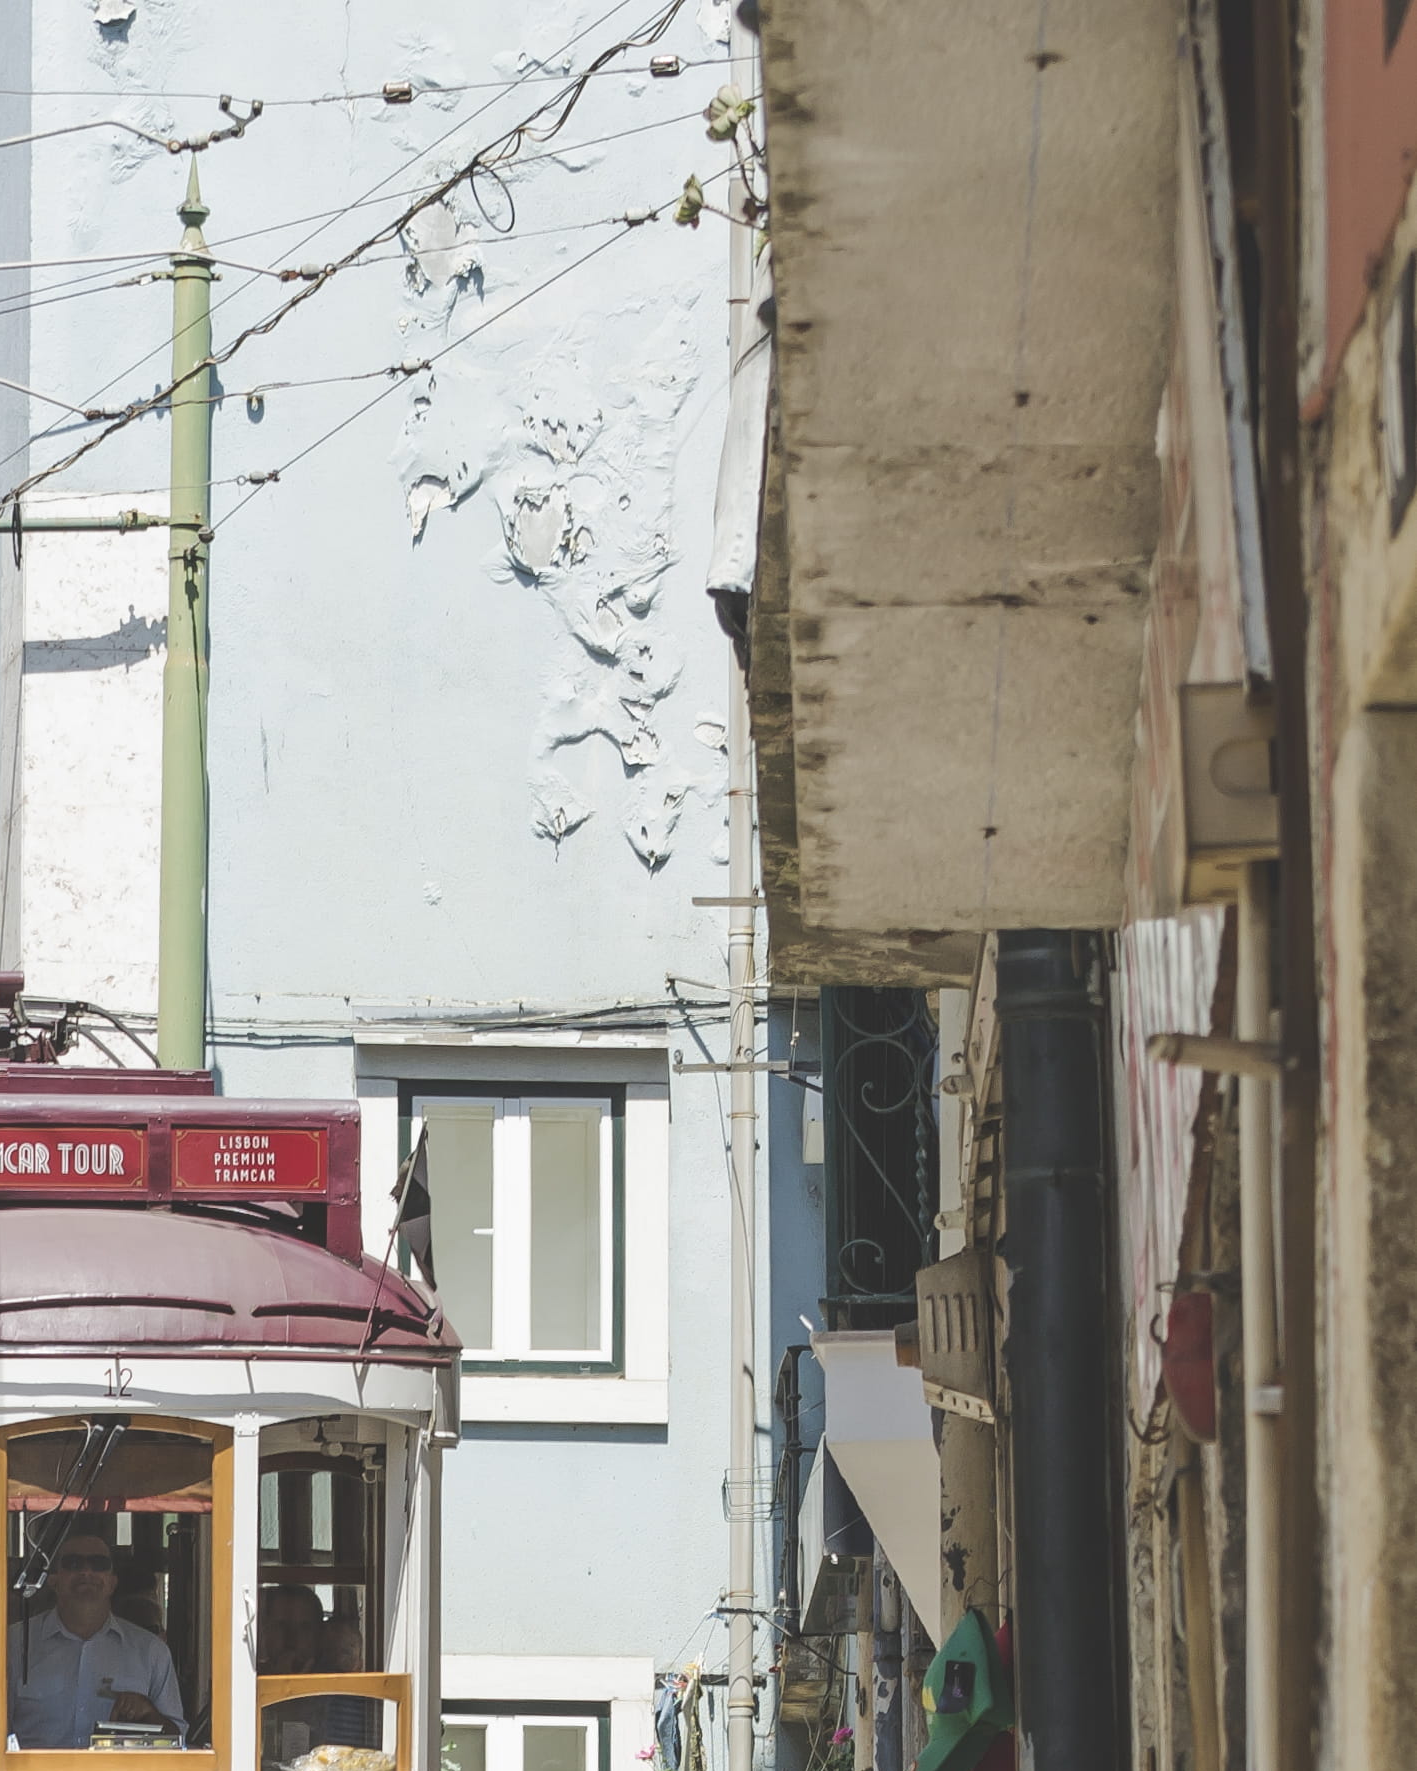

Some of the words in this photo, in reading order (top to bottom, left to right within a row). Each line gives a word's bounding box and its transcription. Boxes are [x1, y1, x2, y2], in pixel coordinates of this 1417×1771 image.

[219, 1135, 269, 1149] LISBON
[57, 1143, 125, 1175] TOUR
[214, 1152, 275, 1166] PREMIUM
[214, 1168, 276, 1182] TRAMCAR
[103, 1367, 133, 1397] 12
